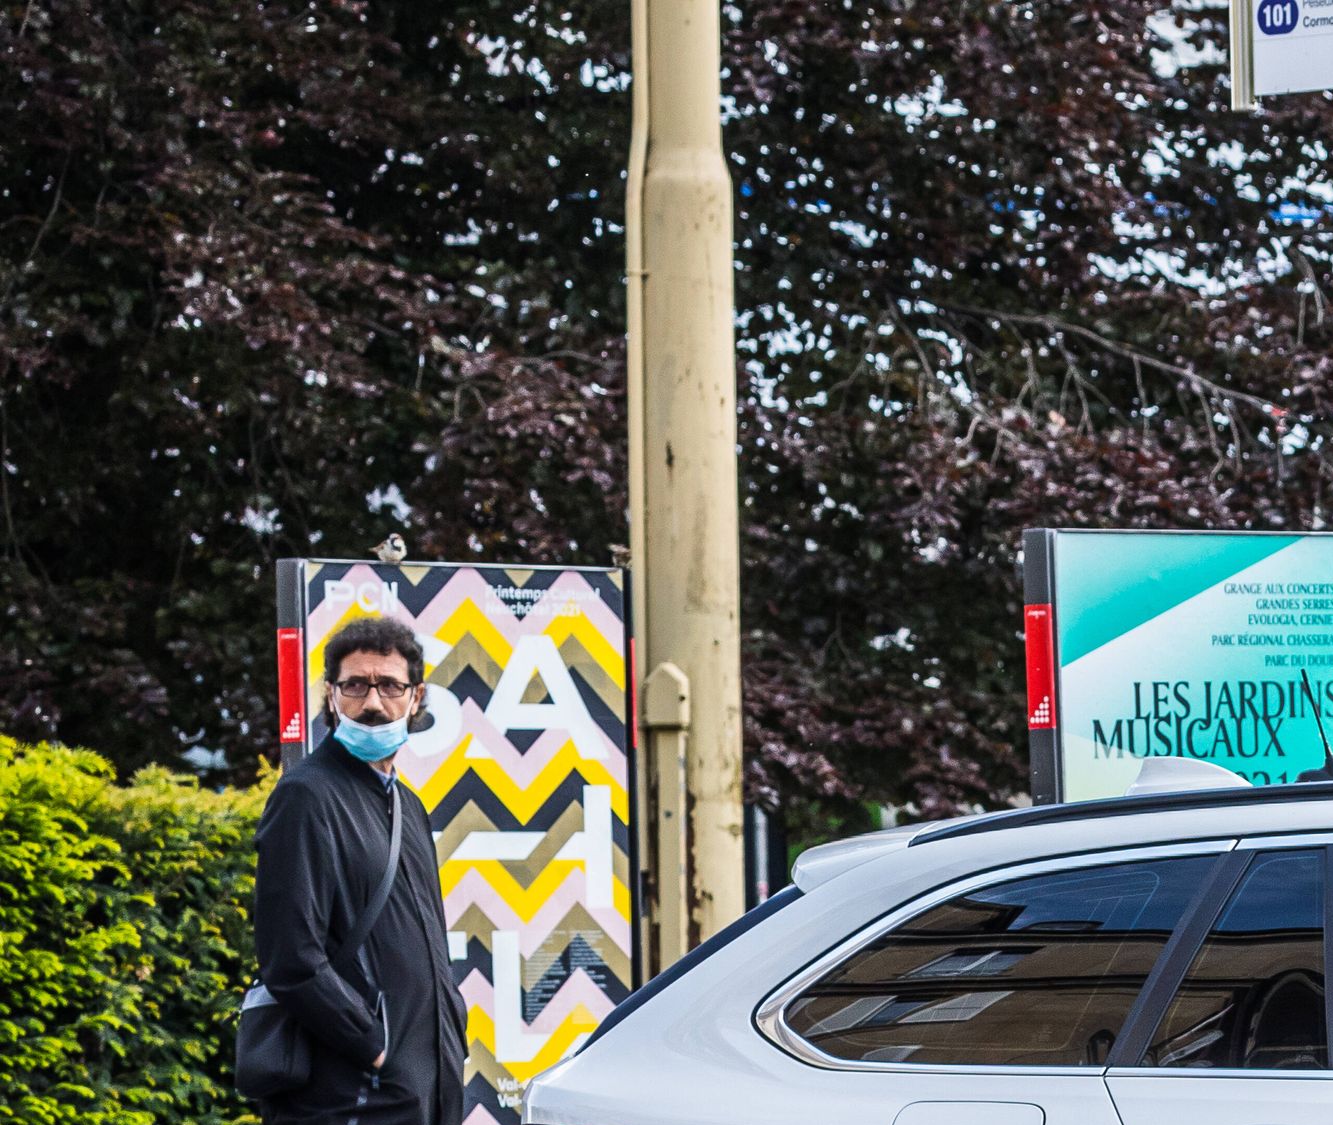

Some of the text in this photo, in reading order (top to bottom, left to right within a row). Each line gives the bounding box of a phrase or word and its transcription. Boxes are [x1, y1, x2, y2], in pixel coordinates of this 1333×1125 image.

[1263, 4, 1292, 28] 101
[325, 581, 398, 613] PCN
[485, 584, 548, 602] Printemps
[1224, 583, 1262, 595] GRANGE
[1265, 583, 1283, 595] AUX
[1255, 598, 1300, 610] GRANDES
[1211, 634, 1235, 646] PARC
[1238, 631, 1284, 646] RÉGIONAL
[1264, 654, 1289, 667] PARC
[1290, 654, 1305, 667] DU
[1133, 681, 1191, 720] LES
[1093, 717, 1286, 758] MUSICAUX
